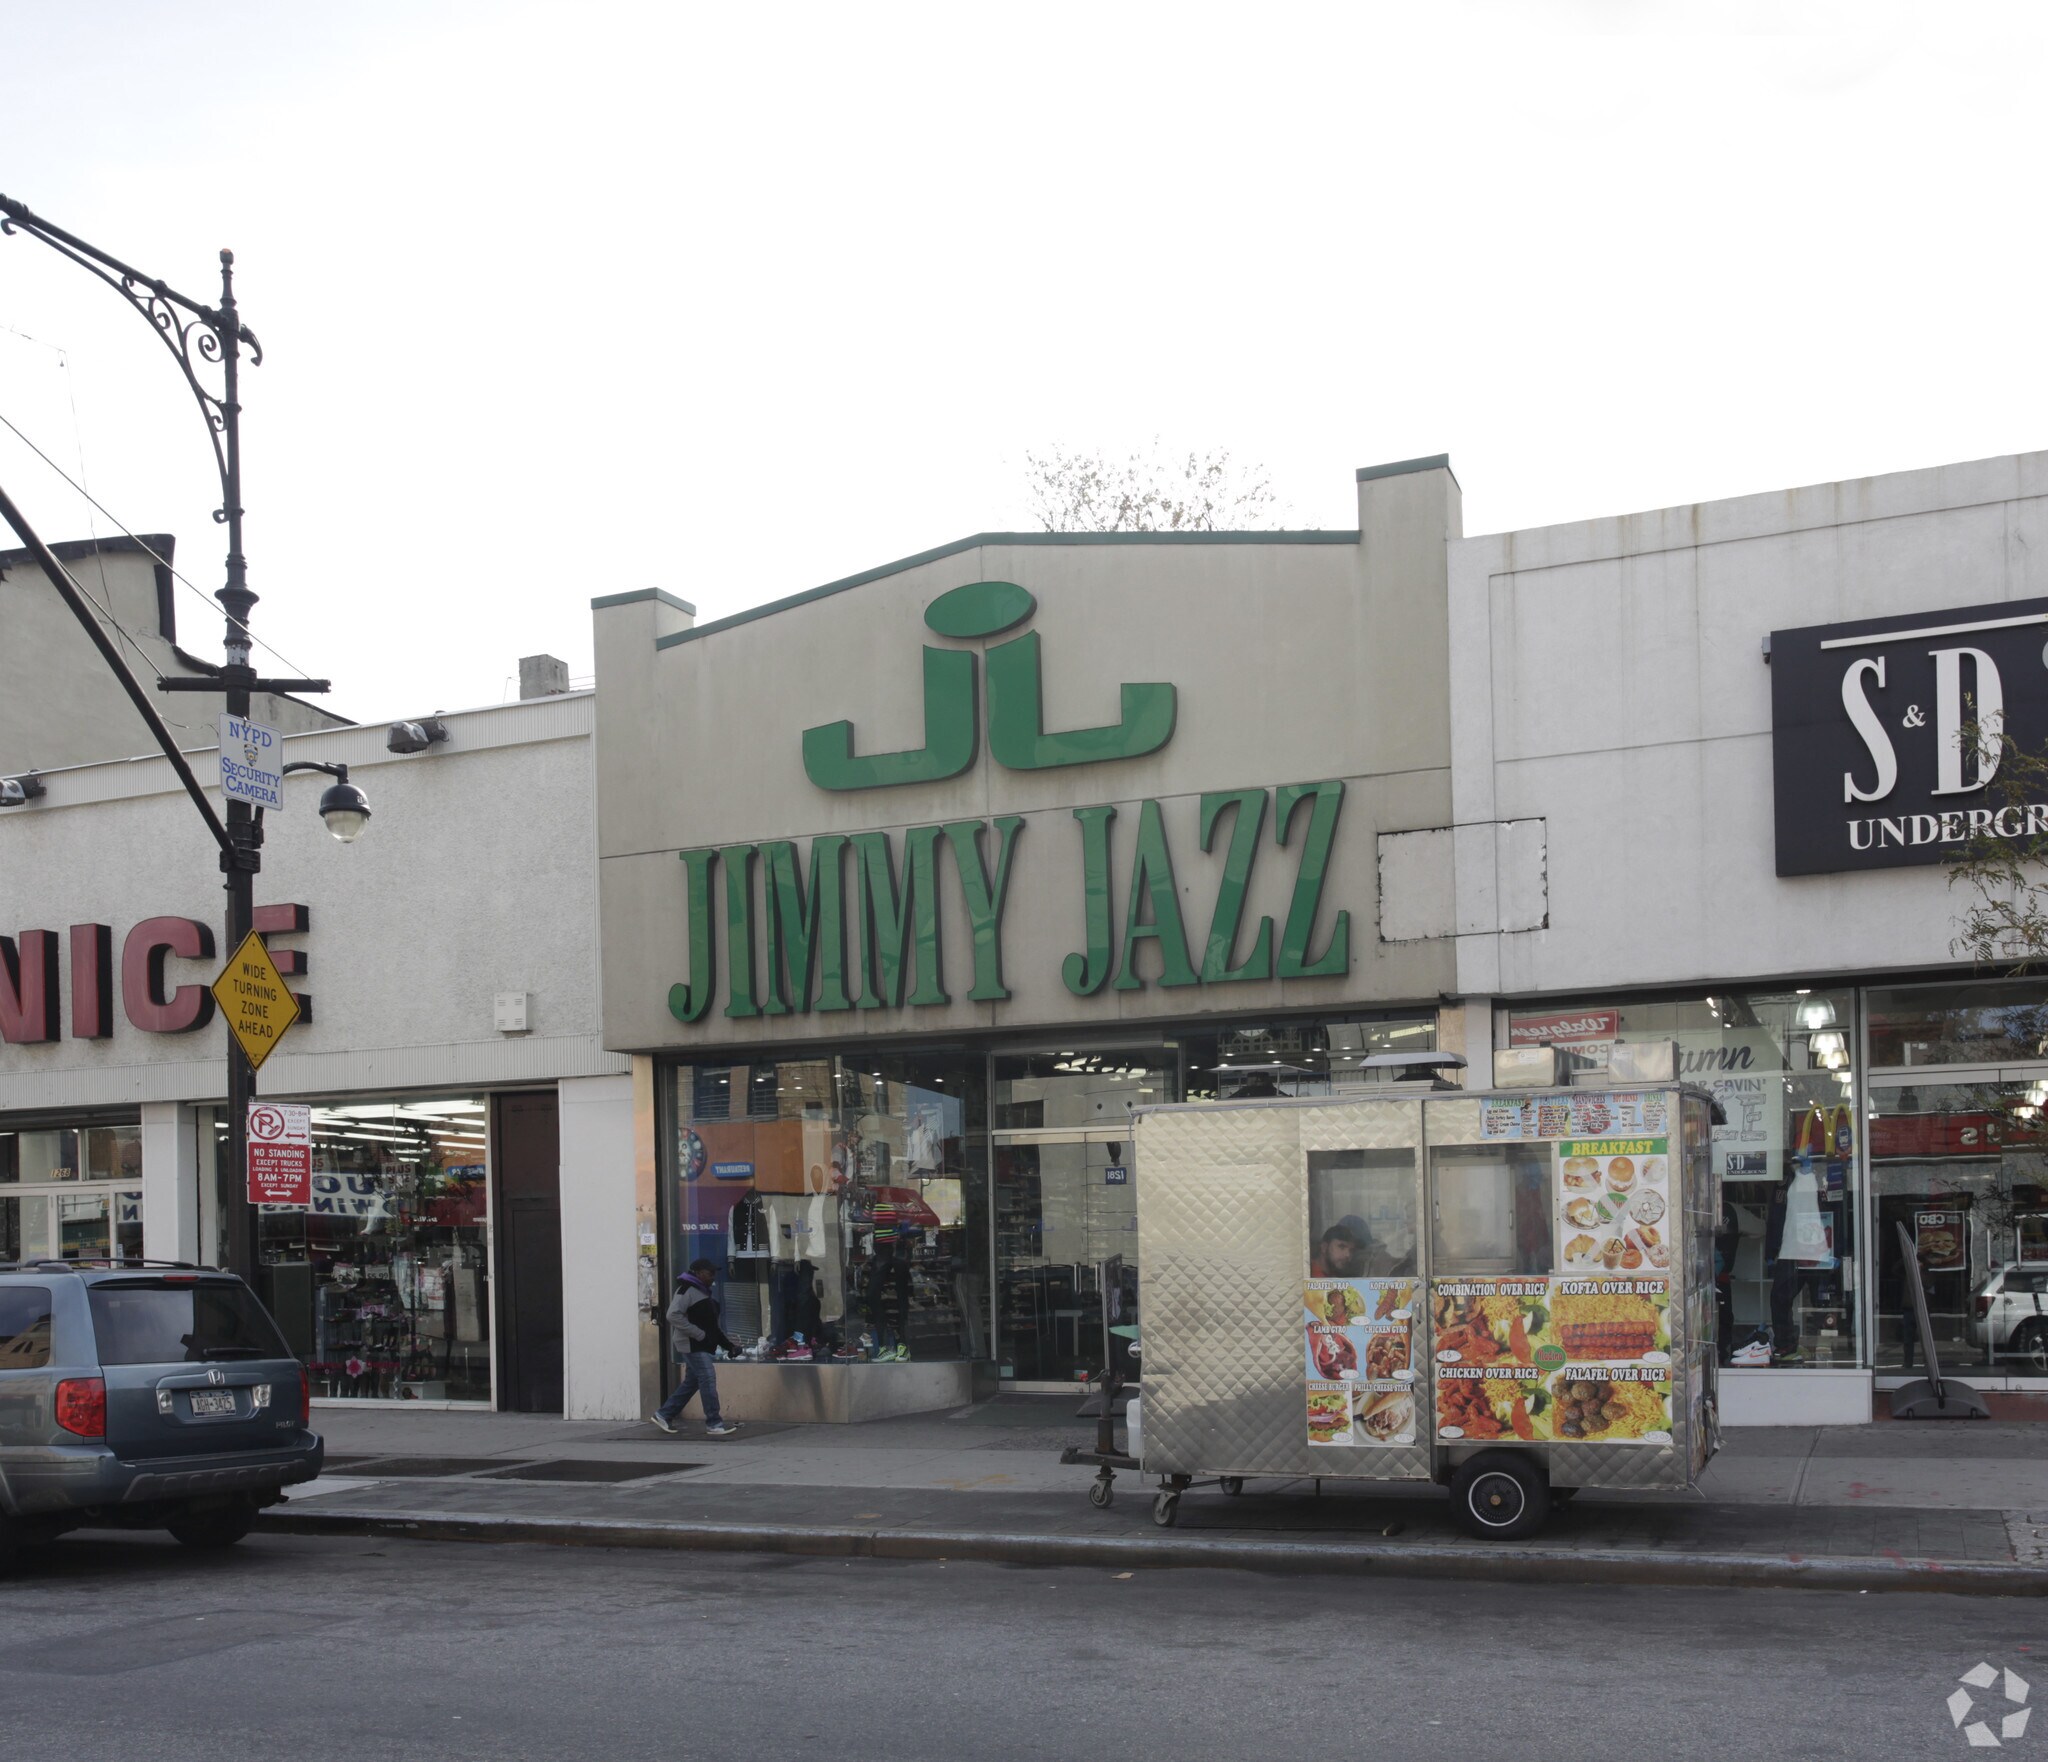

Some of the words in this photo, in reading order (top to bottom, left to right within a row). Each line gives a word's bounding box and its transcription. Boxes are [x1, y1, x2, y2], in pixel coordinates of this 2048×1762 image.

[229, 721, 272, 747] NYPD
[222, 756, 280, 788] SECURITY
[226, 775, 278, 803] CAMERA
[668, 815, 1026, 1023] JIMMY
[1062, 780, 1350, 997] JAZZ
[242, 962, 266, 980] WIDE
[233, 979, 277, 1001] TURNING
[241, 1000, 269, 1019] ZONE
[238, 1019, 273, 1038] AHEAD
[254, 1148, 265, 1157] NO
[268, 1149, 305, 1158] STANDING
[1571, 1141, 1653, 1156] BREAKFAST
[385, 1164, 411, 1174] PLUS
[1307, 1282, 1331, 1290] FALAFEL
[1333, 1282, 1349, 1290] WRAP
[1370, 1282, 1391, 1290] KOFTA
[1437, 1283, 1496, 1297] COMBINATION
[1500, 1283, 1524, 1296] OVER
[1524, 1282, 1546, 1296] RICE
[1561, 1281, 1599, 1295] KOFTA
[1601, 1281, 1635, 1295] OVER
[1636, 1280, 1664, 1294] RICE
[1313, 1325, 1330, 1334] LAMB
[1331, 1325, 1347, 1334] GYRO
[1364, 1325, 1390, 1333] CHICKEN
[1391, 1325, 1408, 1333] GYRO
[1439, 1367, 1483, 1380] CHICKEN
[1485, 1367, 1514, 1380] OVER
[1514, 1367, 1539, 1380] RICE
[1565, 1368, 1609, 1381] FALAFEL
[1610, 1368, 1640, 1382] OVER
[1641, 1368, 1666, 1382] RICE
[1308, 1383, 1328, 1391] CHEESE
[1328, 1383, 1350, 1391] BURGER
[1354, 1383, 1373, 1391] PHILLY
[1373, 1384, 1393, 1392] CHEESE
[1393, 1383, 1412, 1392] STEAK
